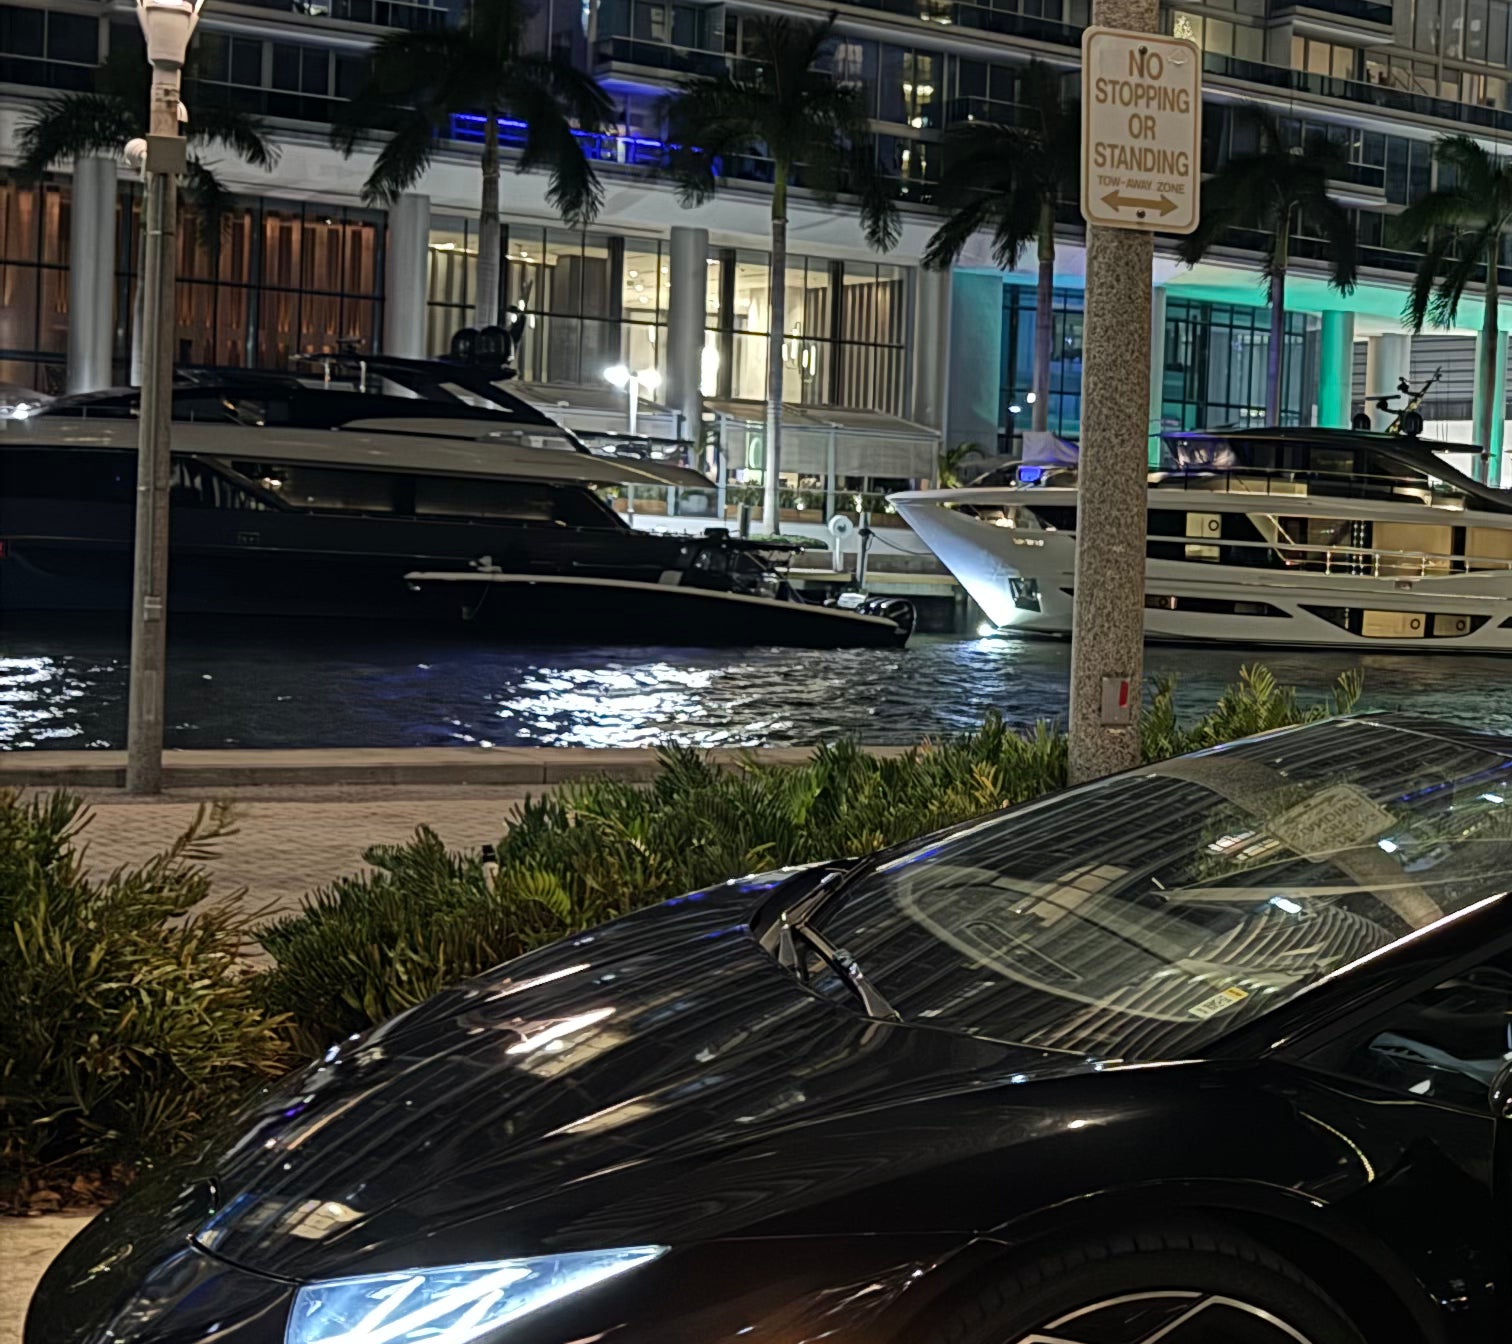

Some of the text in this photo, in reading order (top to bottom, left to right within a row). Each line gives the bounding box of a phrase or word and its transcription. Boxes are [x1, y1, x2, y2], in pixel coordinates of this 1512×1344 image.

[1128, 49, 1164, 81] NO
[1095, 77, 1190, 114] STOPPING
[1128, 113, 1156, 141] OR
[1094, 142, 1189, 177] STANDING
[1096, 174, 1185, 195] TOW-AWAY ZONE
